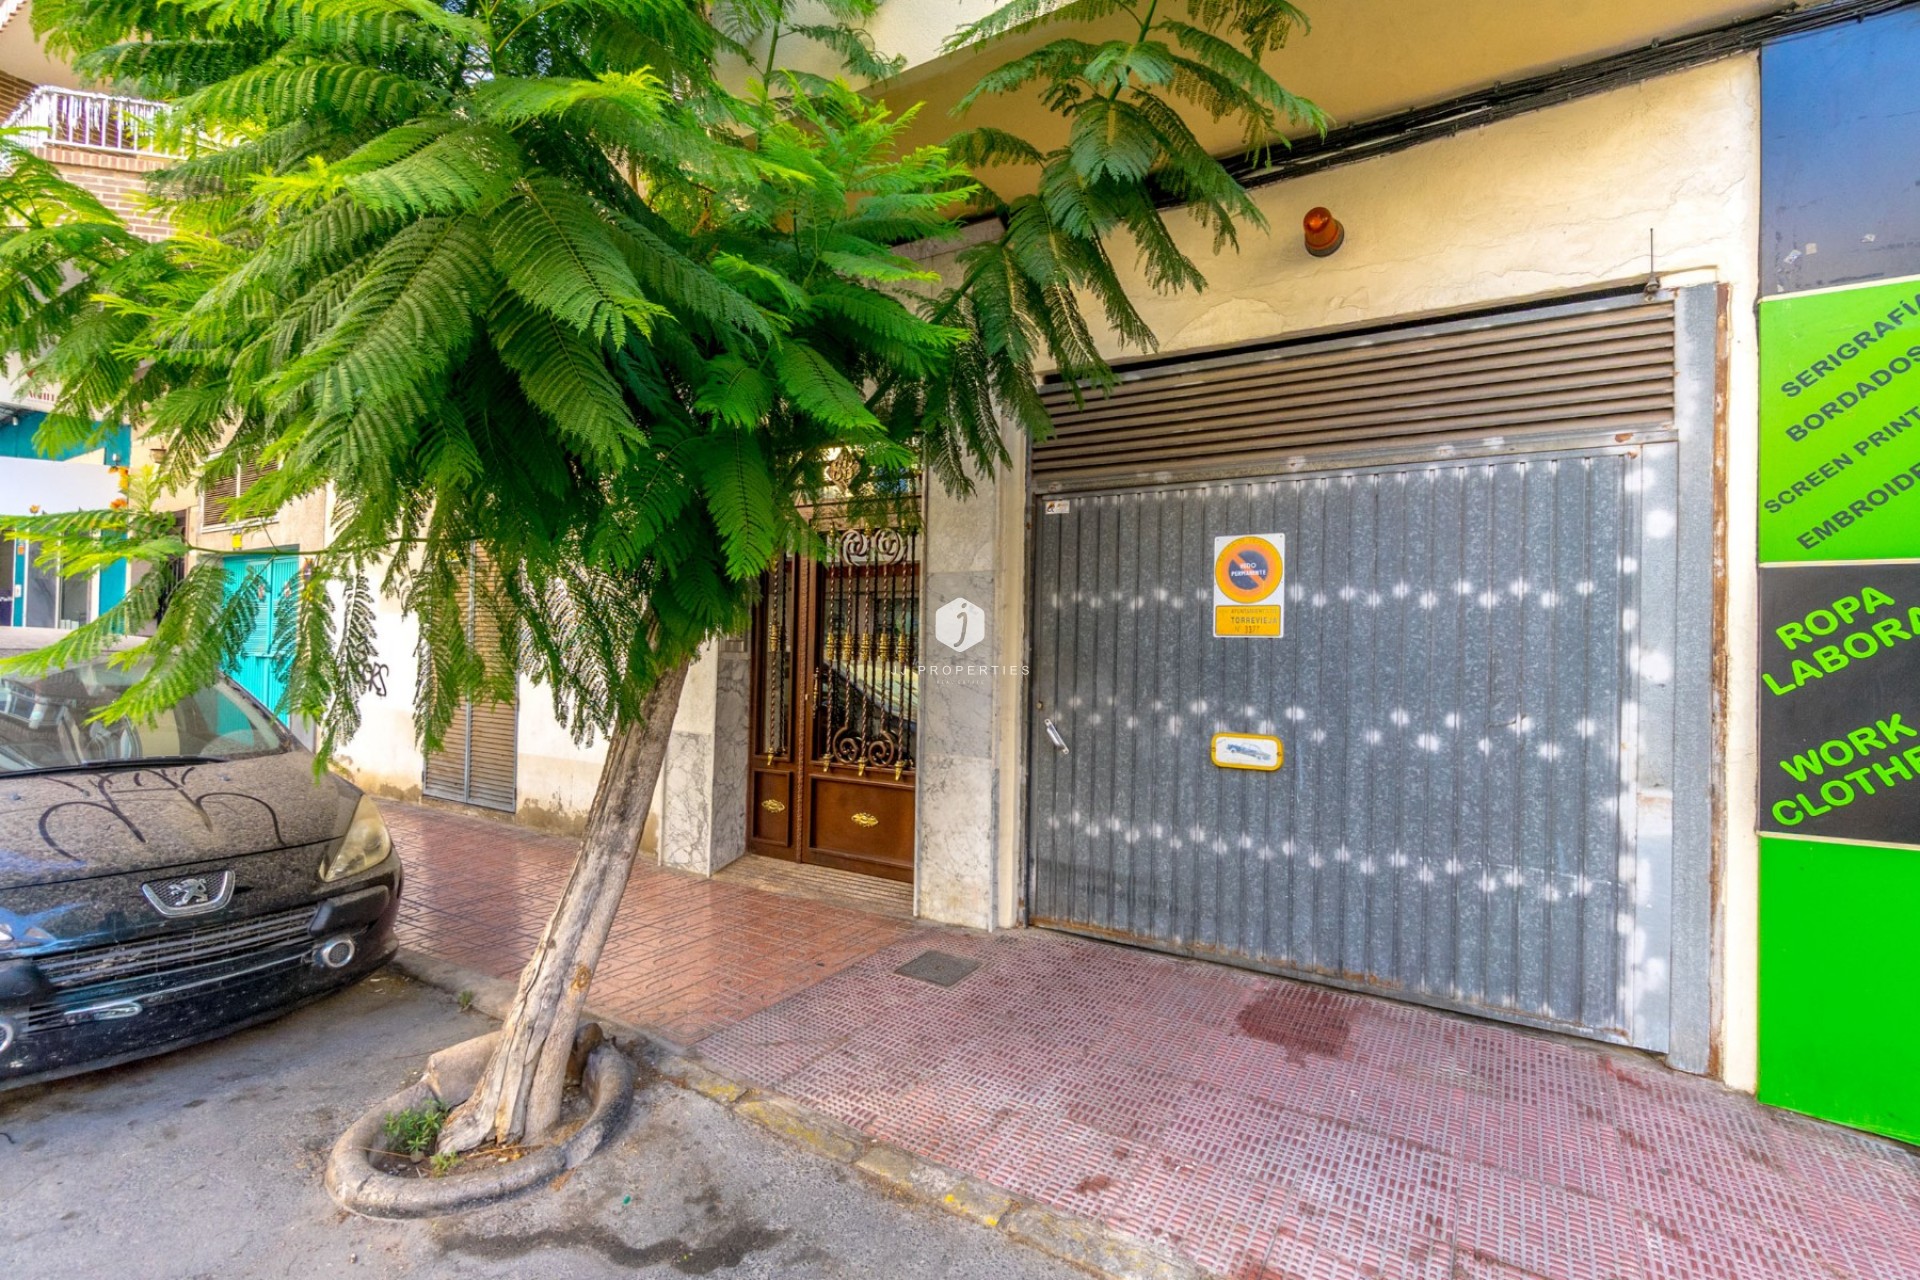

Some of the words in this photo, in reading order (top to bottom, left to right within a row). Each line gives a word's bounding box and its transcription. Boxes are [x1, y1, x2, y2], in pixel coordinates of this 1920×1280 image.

[1780, 293, 1920, 397] SERIGRAFÍ
[1785, 345, 1920, 442] BORDADOS
[1763, 452, 1854, 514] SCREEN
[1852, 406, 1920, 457] PRINT
[1231, 616, 1278, 624] TORREVIEJA
[1775, 586, 1896, 651] ROPA
[1779, 713, 1918, 783] WORK
